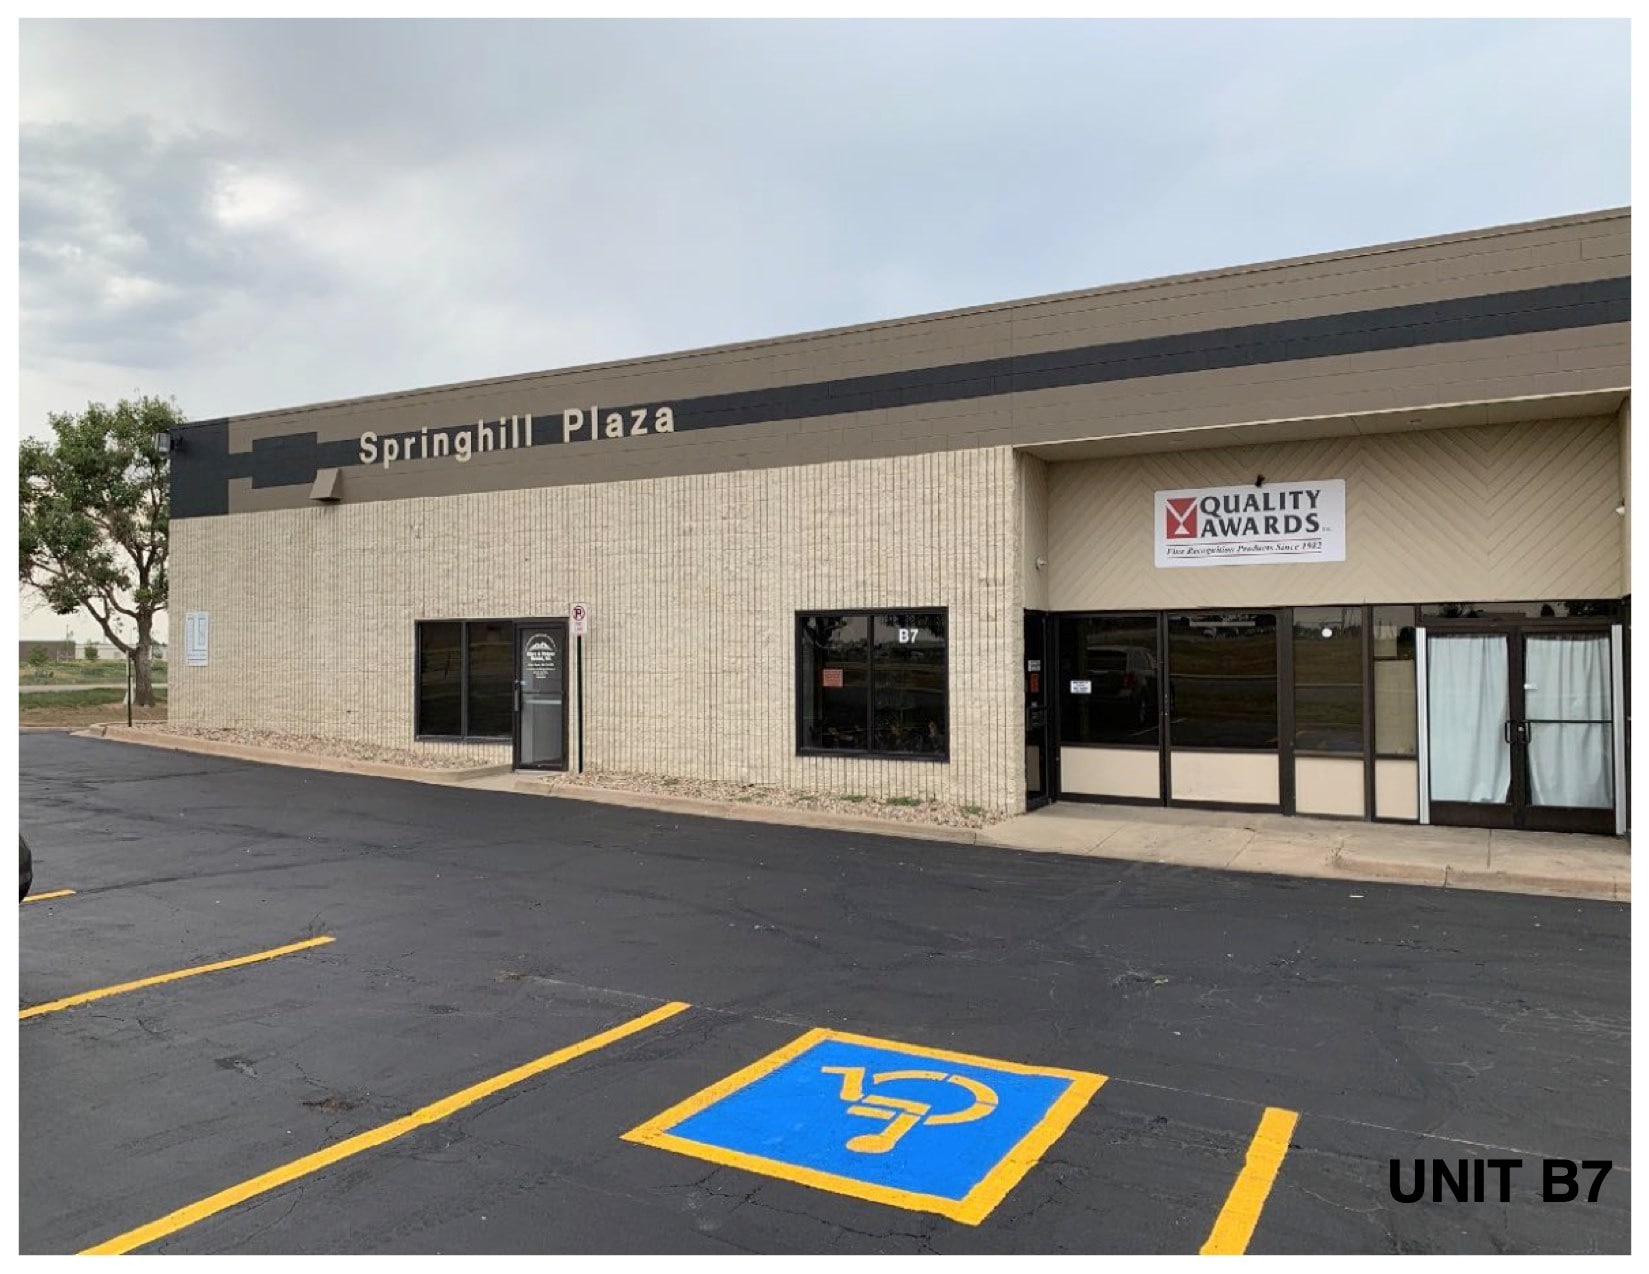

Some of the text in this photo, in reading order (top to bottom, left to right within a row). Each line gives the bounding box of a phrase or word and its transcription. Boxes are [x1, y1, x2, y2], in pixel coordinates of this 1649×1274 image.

[359, 404, 675, 469] Springhill Plaza
[1199, 489, 1322, 518] QUALITY
[1200, 512, 1320, 539] AWARDS
[1236, 544, 1274, 553] Products
[1275, 542, 1300, 551] Since
[898, 628, 919, 643] B7
